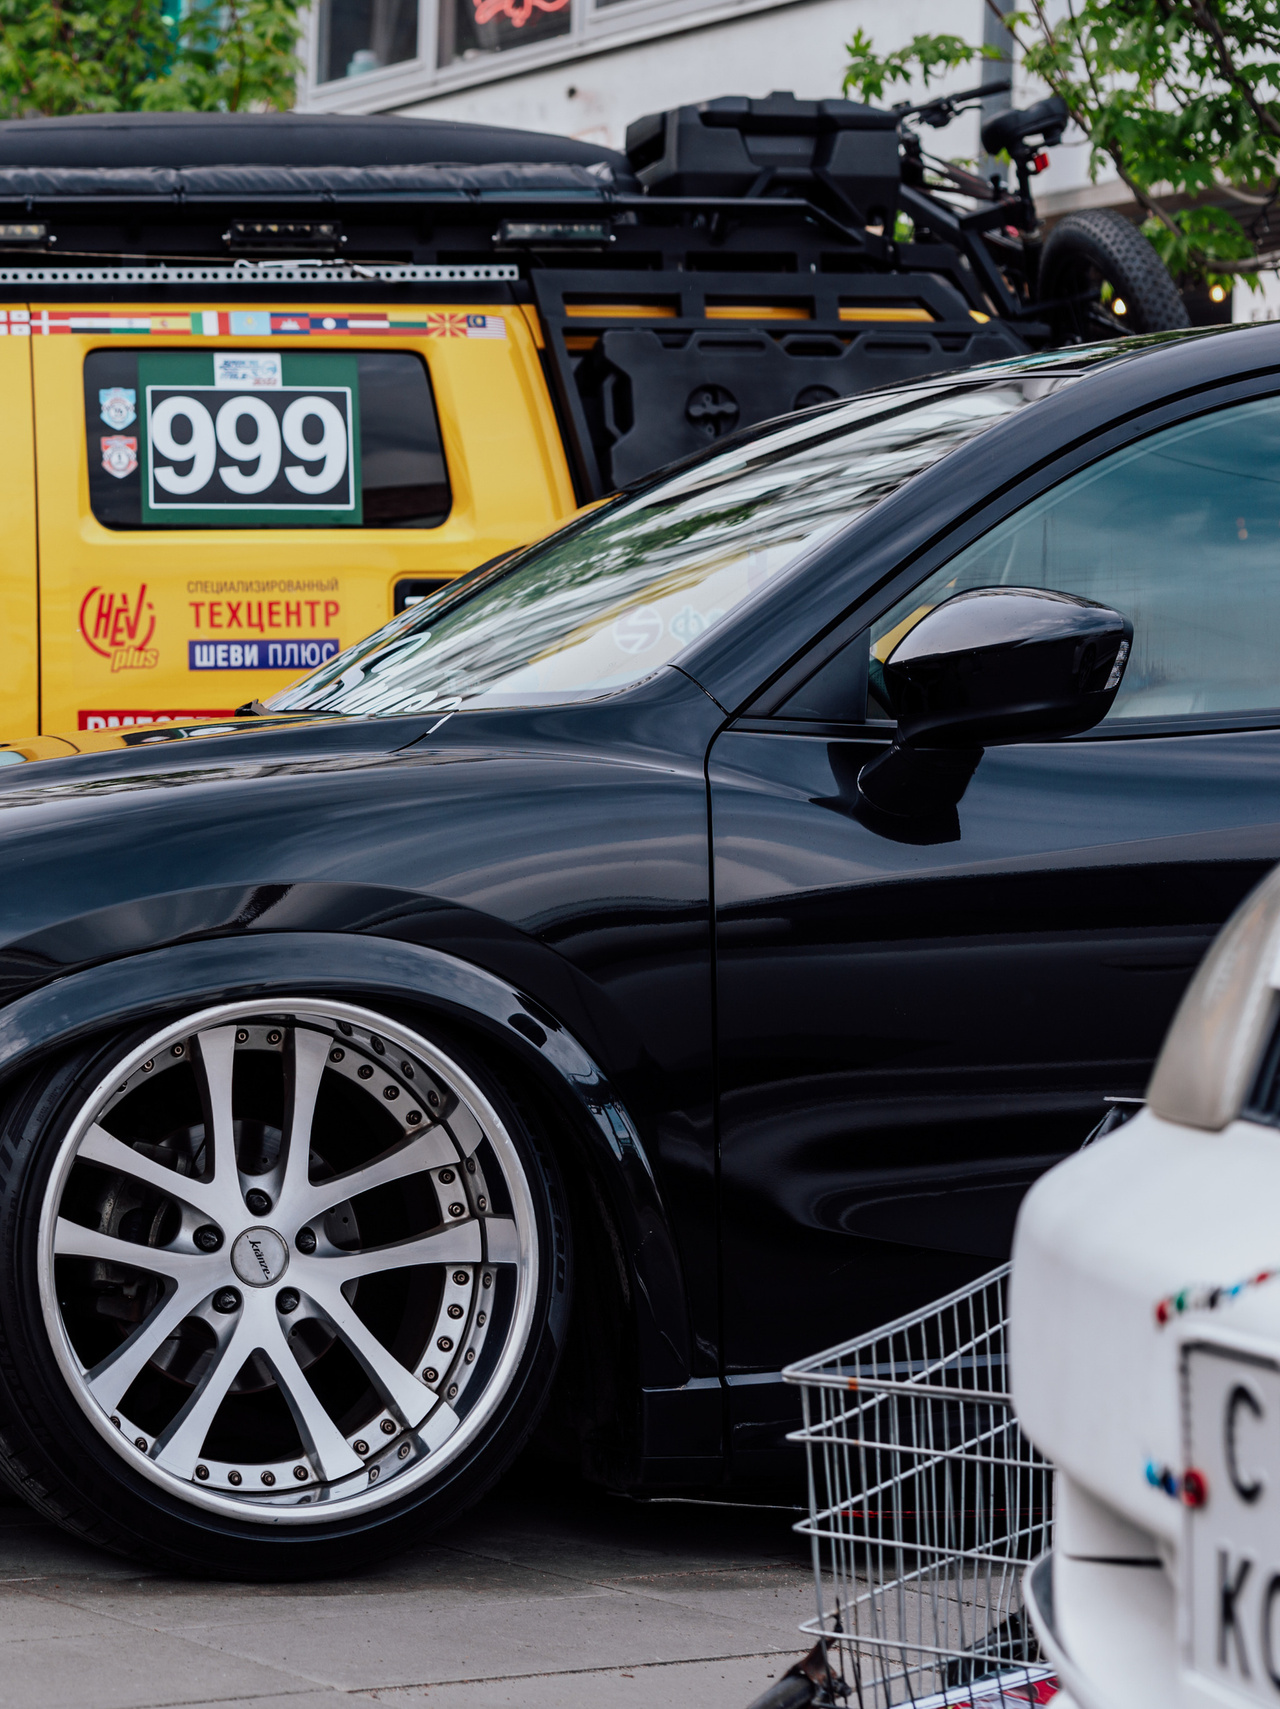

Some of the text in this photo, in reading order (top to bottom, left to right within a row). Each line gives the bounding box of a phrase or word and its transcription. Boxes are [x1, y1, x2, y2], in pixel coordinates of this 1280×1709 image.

[151, 395, 347, 495] 999
[187, 577, 339, 594] СПЕЦИАЛИЗИРОВАННЫЙ
[189, 600, 340, 633] ТЕХЦЕНТР
[194, 642, 336, 667] ШЕВИ ПЛЮС
